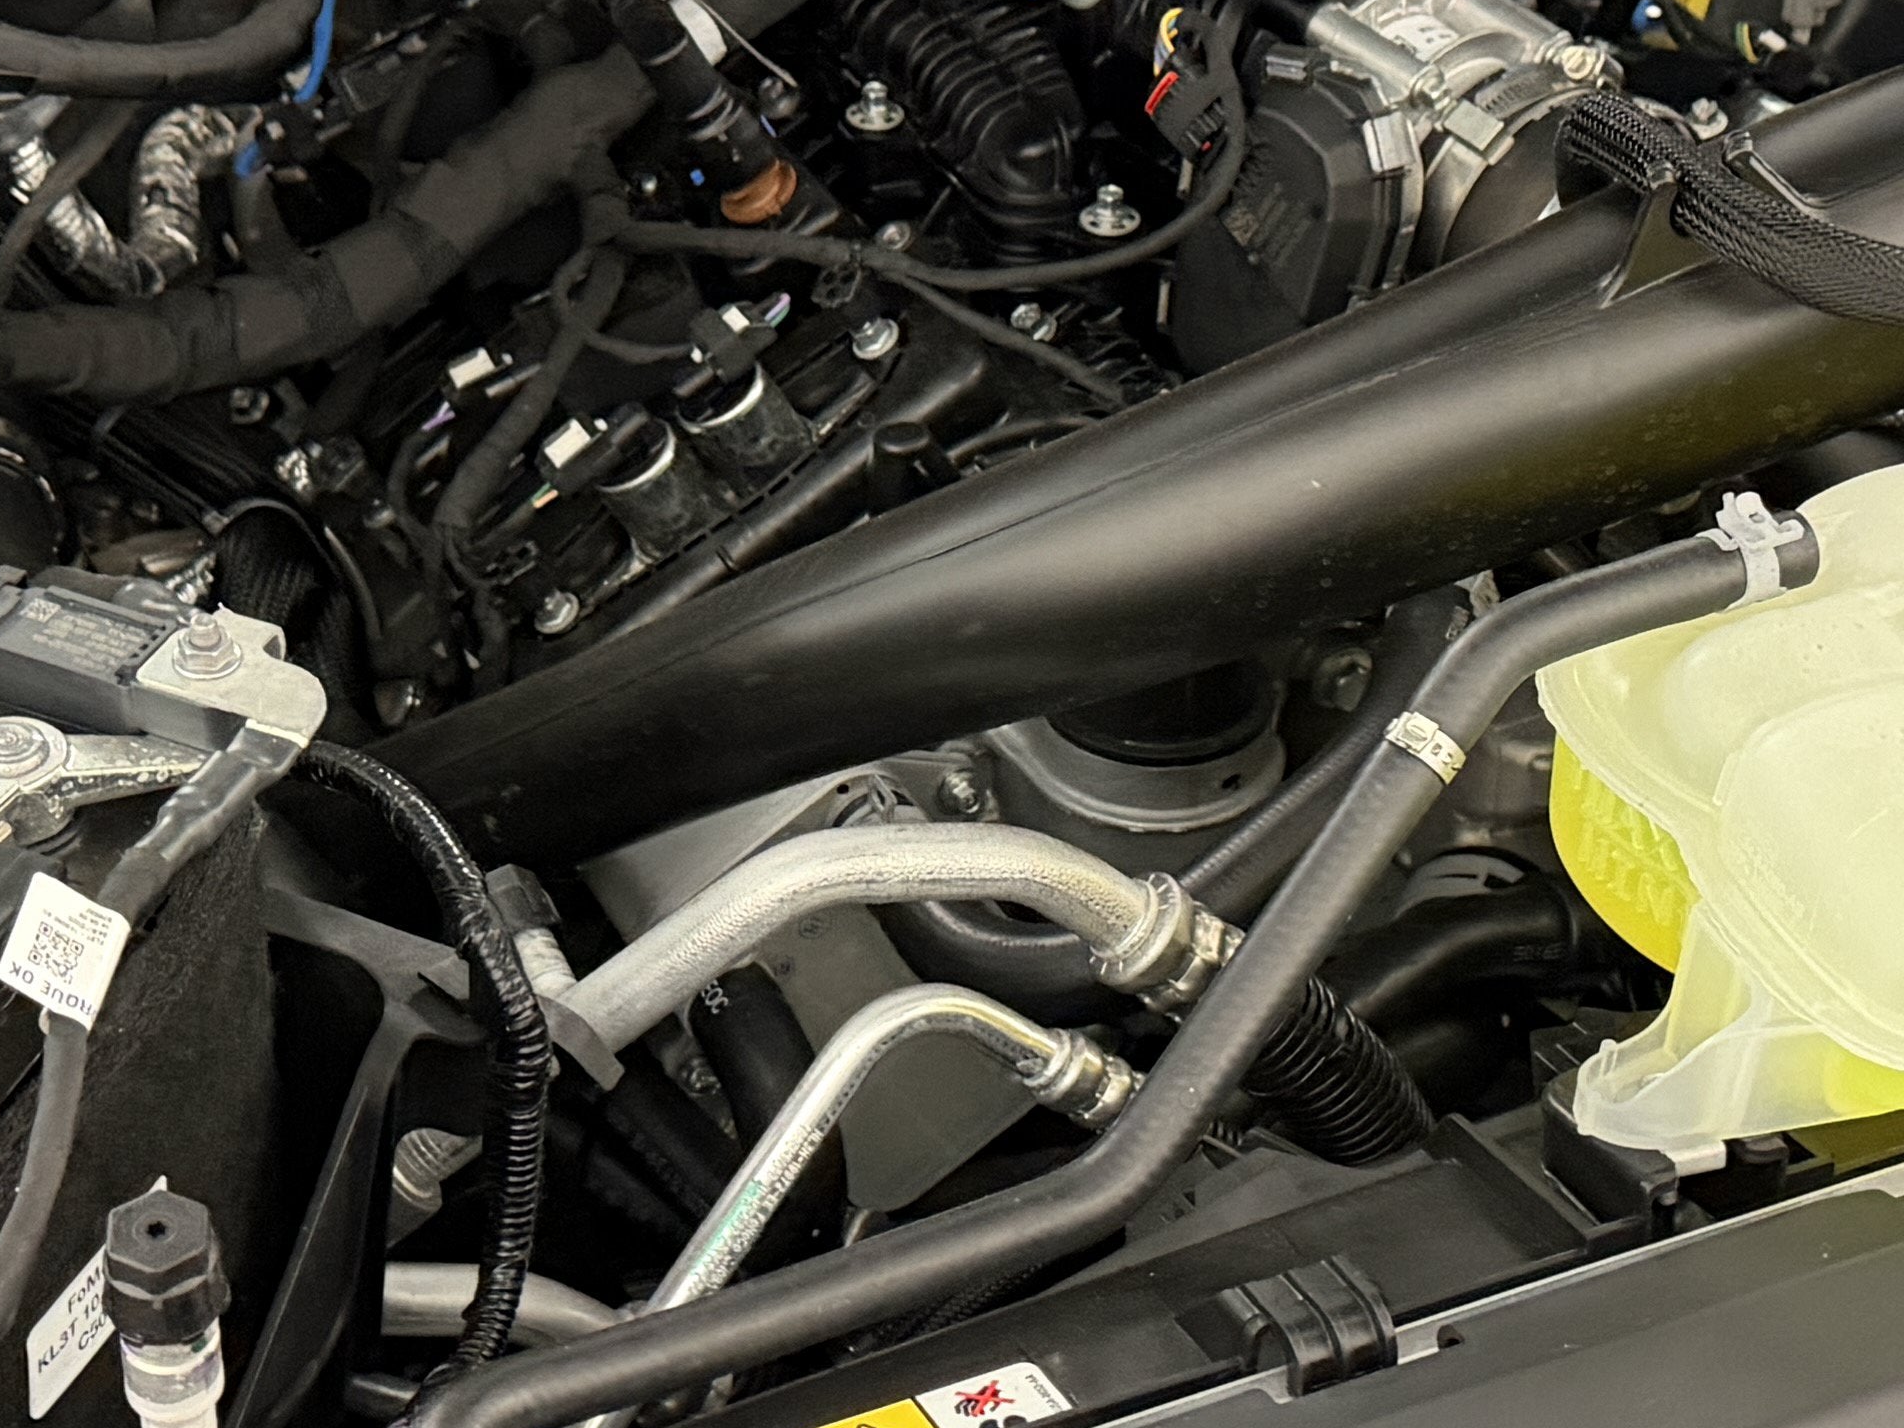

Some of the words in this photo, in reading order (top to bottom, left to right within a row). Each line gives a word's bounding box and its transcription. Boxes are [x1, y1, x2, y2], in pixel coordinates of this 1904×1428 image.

[8, 960, 35, 985] OK
[39, 979, 98, 1017] RQUE
[67, 1266, 103, 1315] FoM
[37, 1317, 79, 1374] KL3T
[83, 1293, 101, 1320] 10
